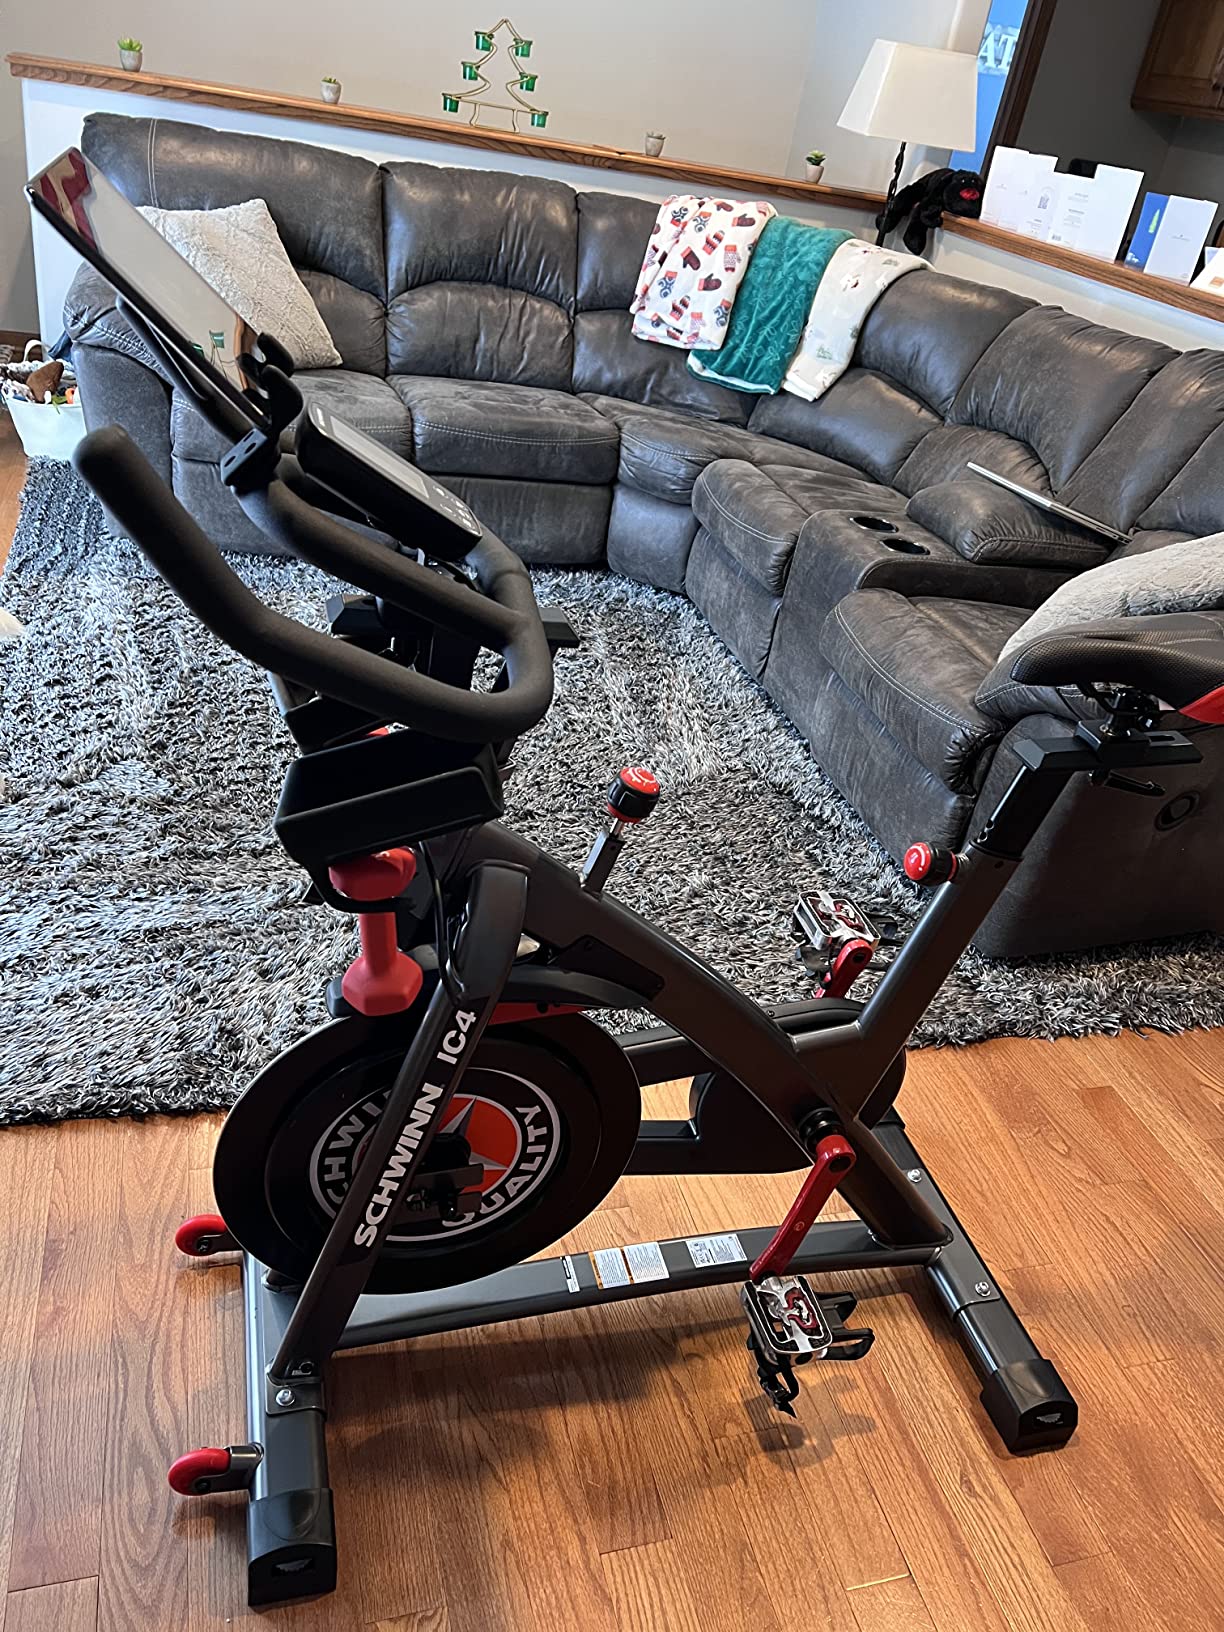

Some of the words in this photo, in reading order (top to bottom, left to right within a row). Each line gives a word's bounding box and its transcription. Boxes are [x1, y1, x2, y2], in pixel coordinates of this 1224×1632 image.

[323, 1089, 392, 1205] CHWI
[354, 1082, 444, 1248] SCHWINN
[436, 1009, 477, 1065] IC4
